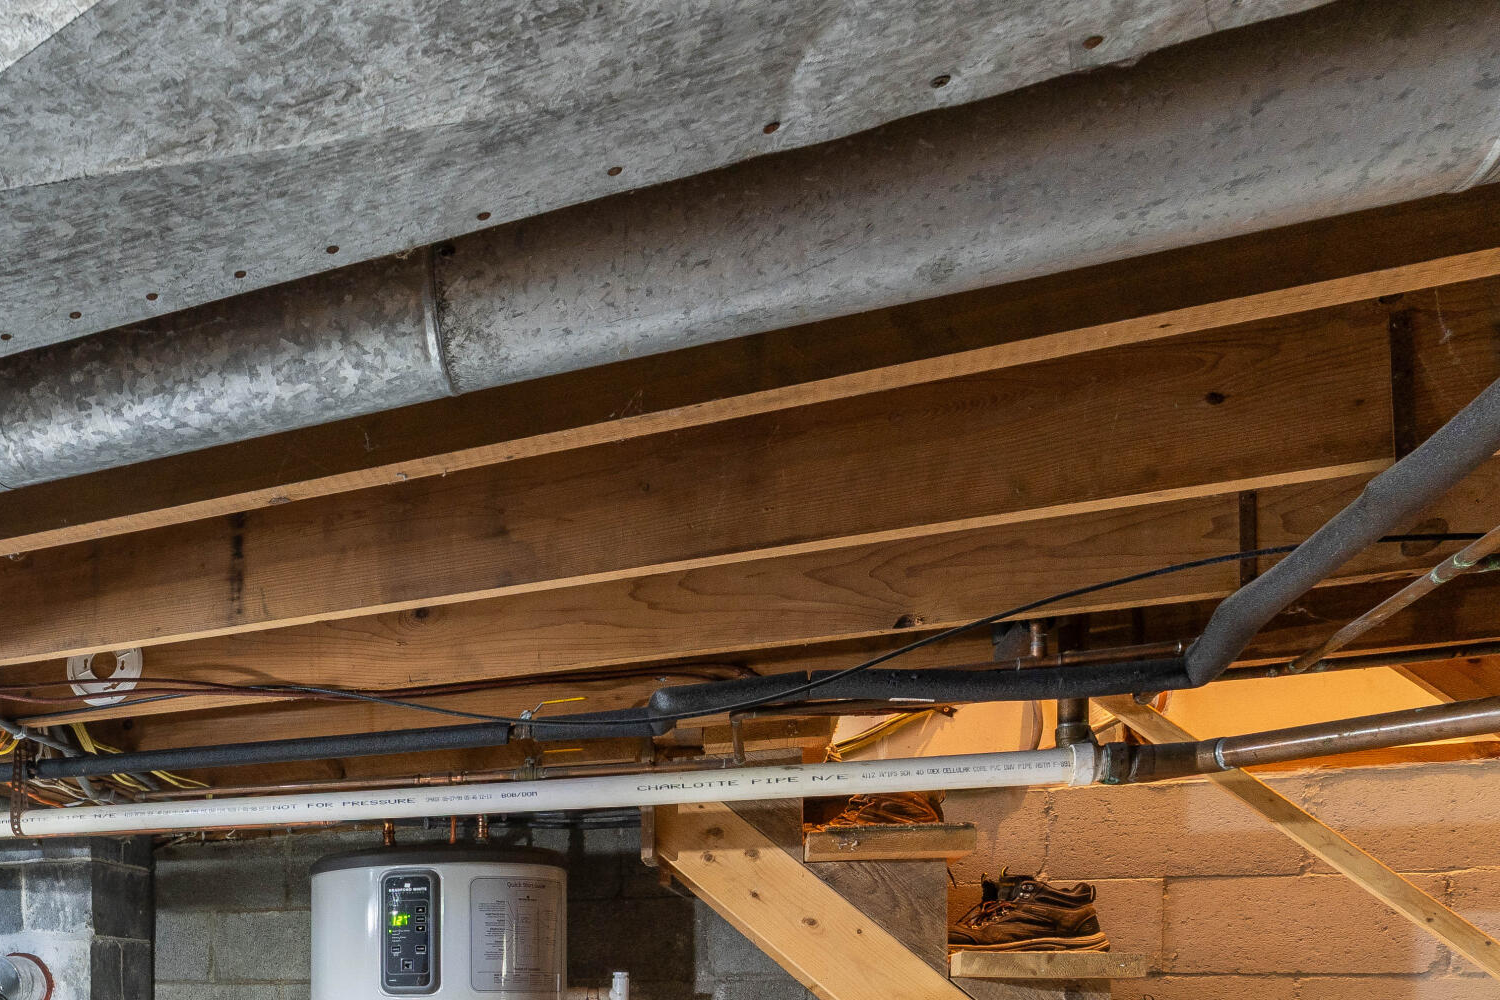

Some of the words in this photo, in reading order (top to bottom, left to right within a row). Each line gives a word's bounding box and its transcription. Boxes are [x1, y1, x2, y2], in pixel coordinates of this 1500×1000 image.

[636, 779, 739, 791] CHARLOTTE
[751, 776, 800, 785] PIPE
[811, 773, 849, 781] N/E
[271, 803, 298, 811] NOT
[342, 797, 416, 807] PRESSURE
